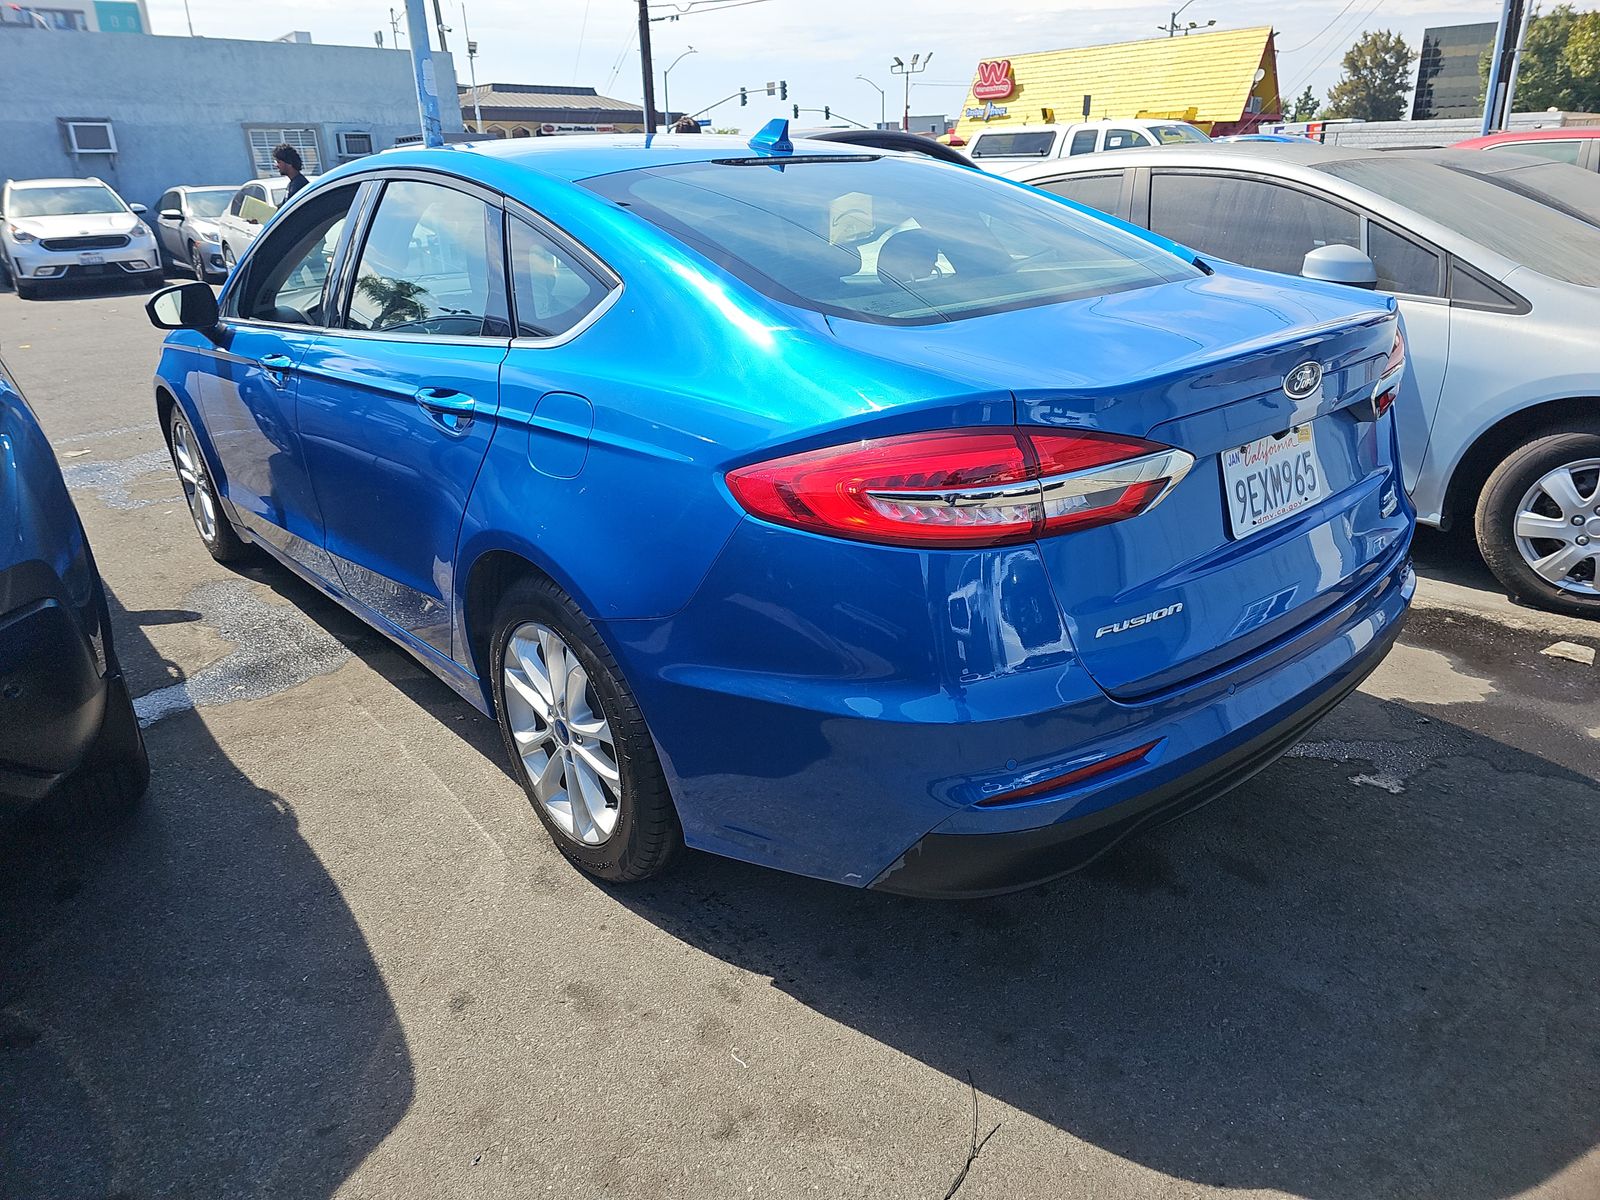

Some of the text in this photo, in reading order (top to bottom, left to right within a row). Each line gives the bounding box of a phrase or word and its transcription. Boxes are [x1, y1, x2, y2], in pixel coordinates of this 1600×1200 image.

[979, 60, 1009, 85] W
[1228, 437, 1299, 467] JAN California
[1236, 451, 1316, 524] 9EXM965
[1257, 500, 1302, 524] dmv.ca.gov
[1095, 602, 1183, 638] FUSION
